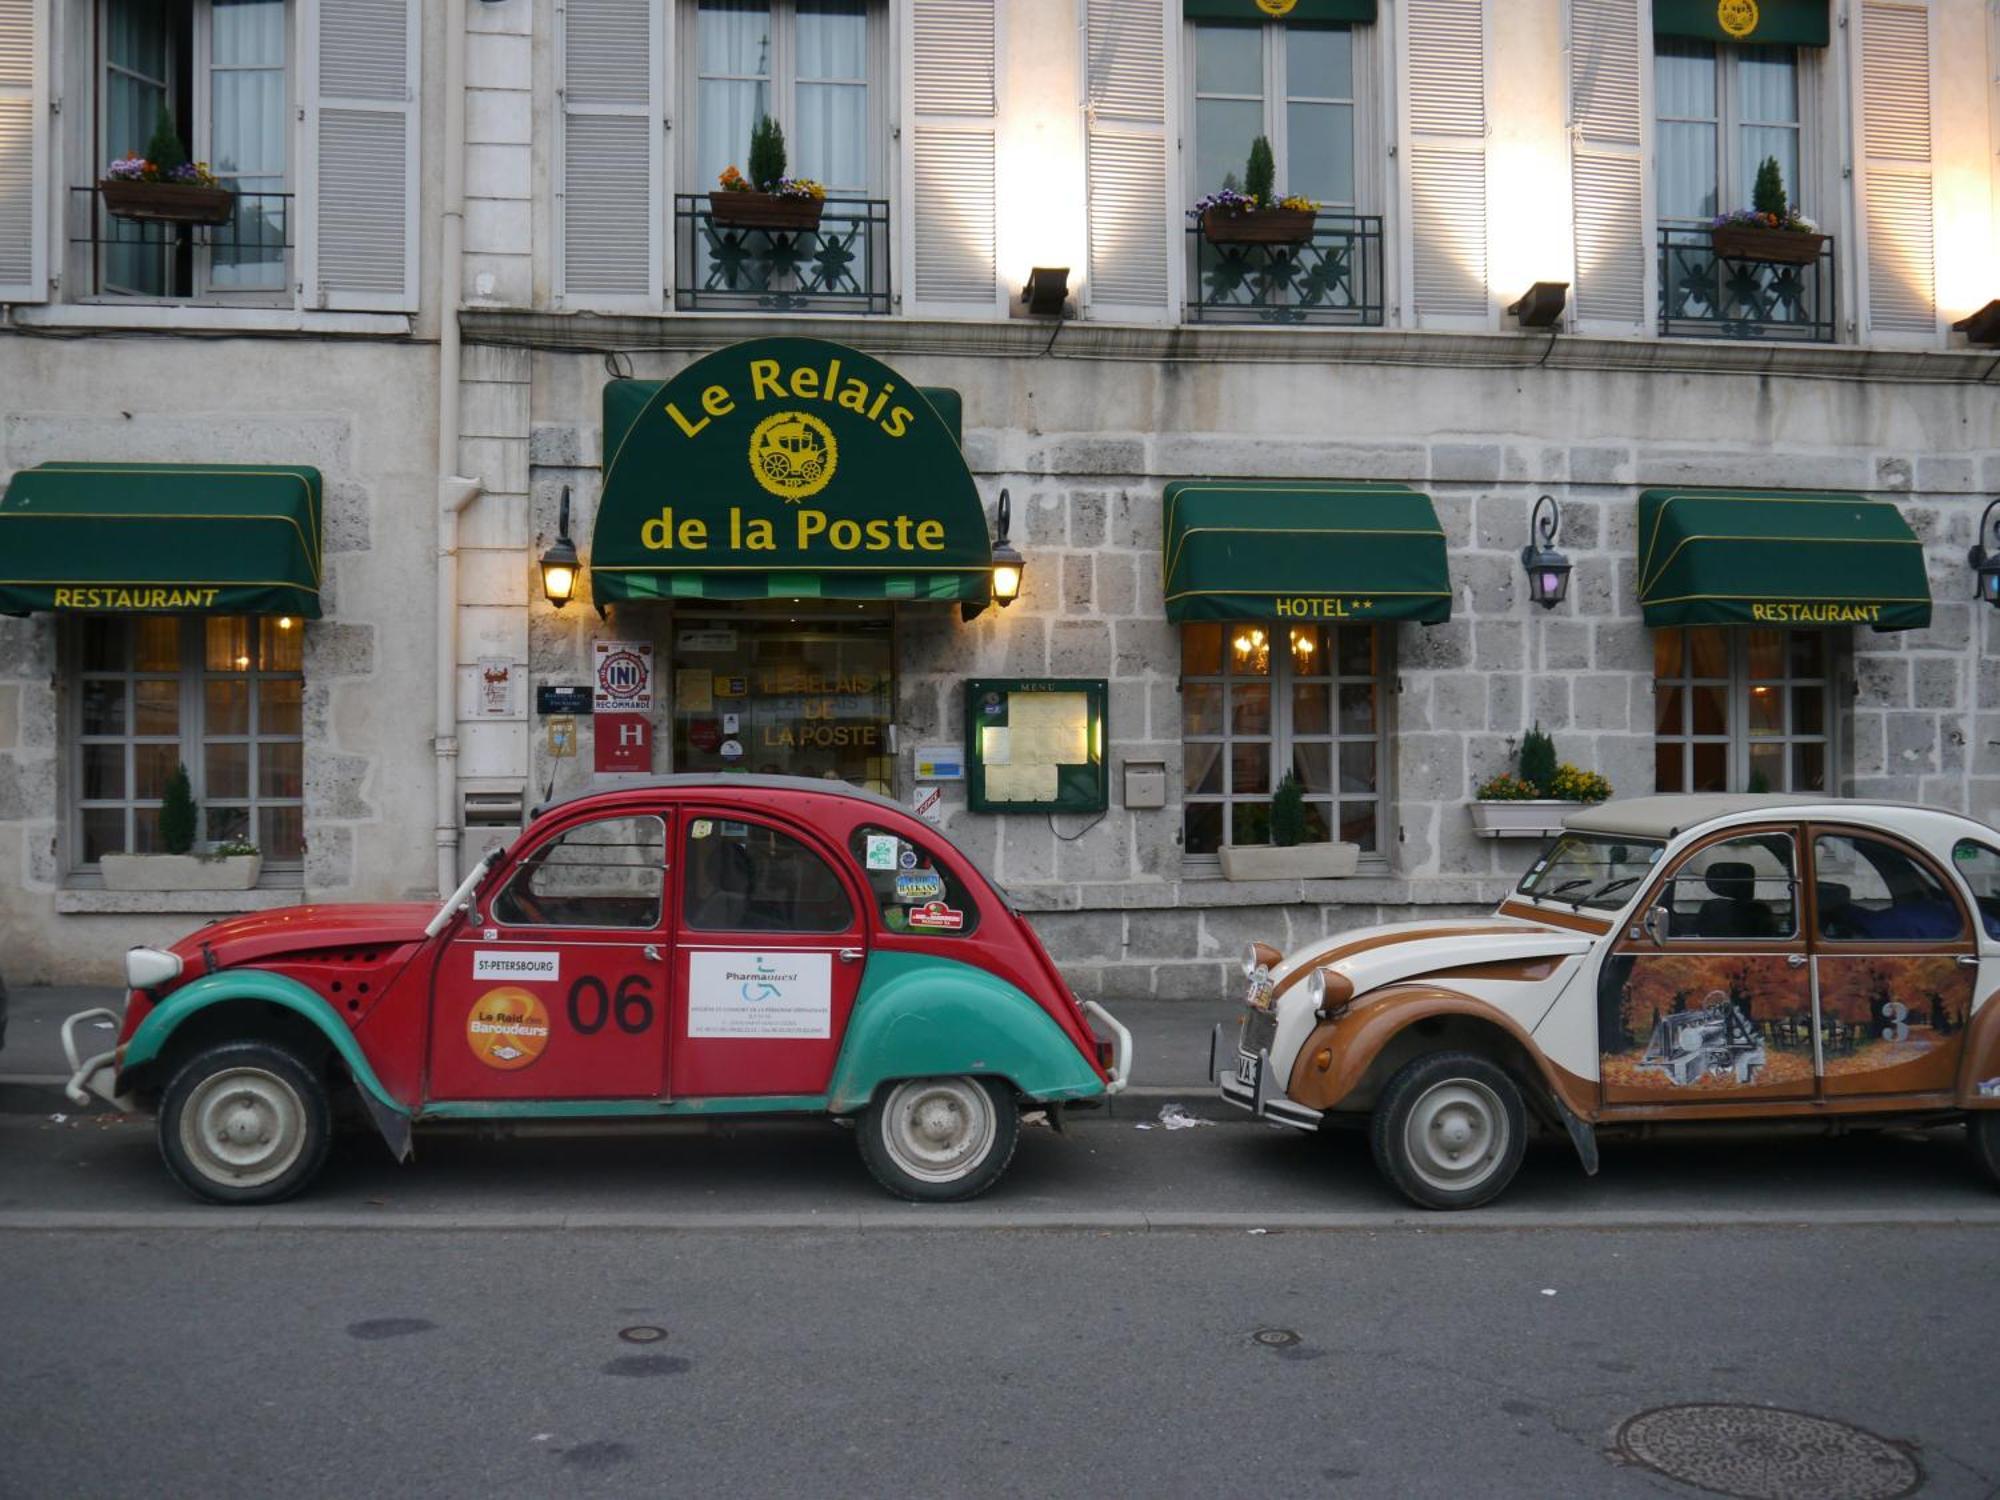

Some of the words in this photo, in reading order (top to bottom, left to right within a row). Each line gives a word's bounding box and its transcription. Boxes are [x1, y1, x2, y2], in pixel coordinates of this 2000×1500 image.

[664, 383, 735, 438] Le
[750, 359, 914, 438] Relais
[641, 507, 708, 550] de
[729, 507, 776, 550] la
[798, 510, 945, 551] Poste
[53, 588, 219, 608] RESTAURANT
[1276, 598, 1349, 617] HOTEL
[1752, 603, 1881, 621] RESTAURANT
[1020, 683, 1056, 691] MENU
[804, 699, 833, 720] DE
[620, 724, 643, 746] H
[764, 726, 795, 746] LA
[800, 726, 876, 746] POSTE
[478, 960, 554, 972] ST-PETERSBOURG
[567, 974, 654, 1035] 06
[470, 1020, 549, 1036] Baroudeurs
[1881, 1002, 1910, 1042] 3
